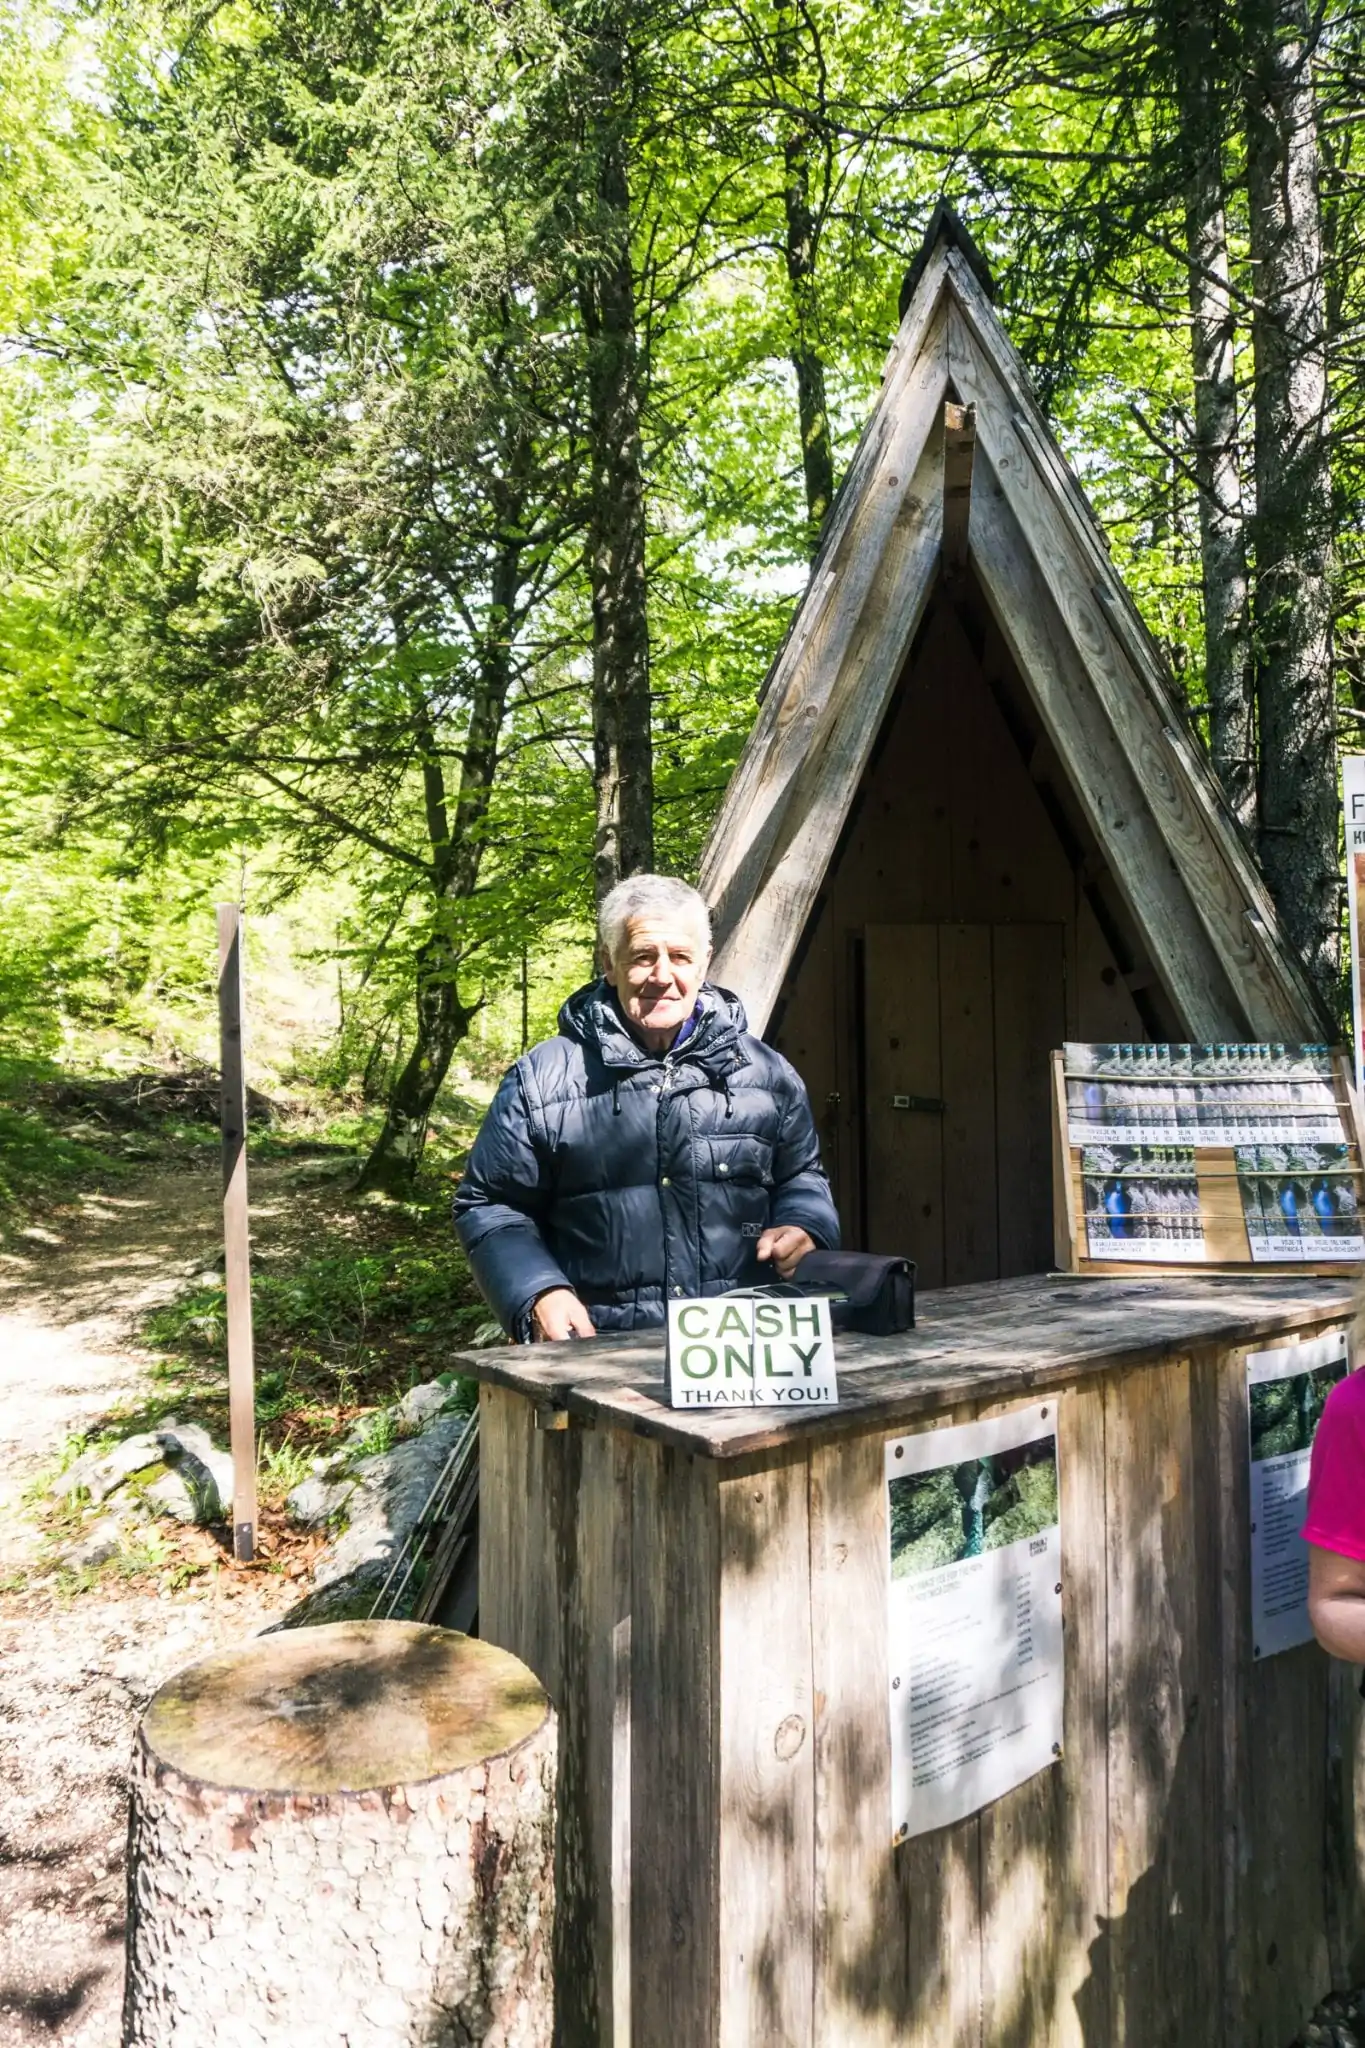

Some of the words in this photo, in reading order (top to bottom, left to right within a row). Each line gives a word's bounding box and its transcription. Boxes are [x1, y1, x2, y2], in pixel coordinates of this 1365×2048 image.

[678, 1304, 821, 1339] CASH
[680, 1342, 822, 1379] ONLY
[681, 1389, 764, 1403] THANK
[771, 1387, 830, 1401] YOU!
